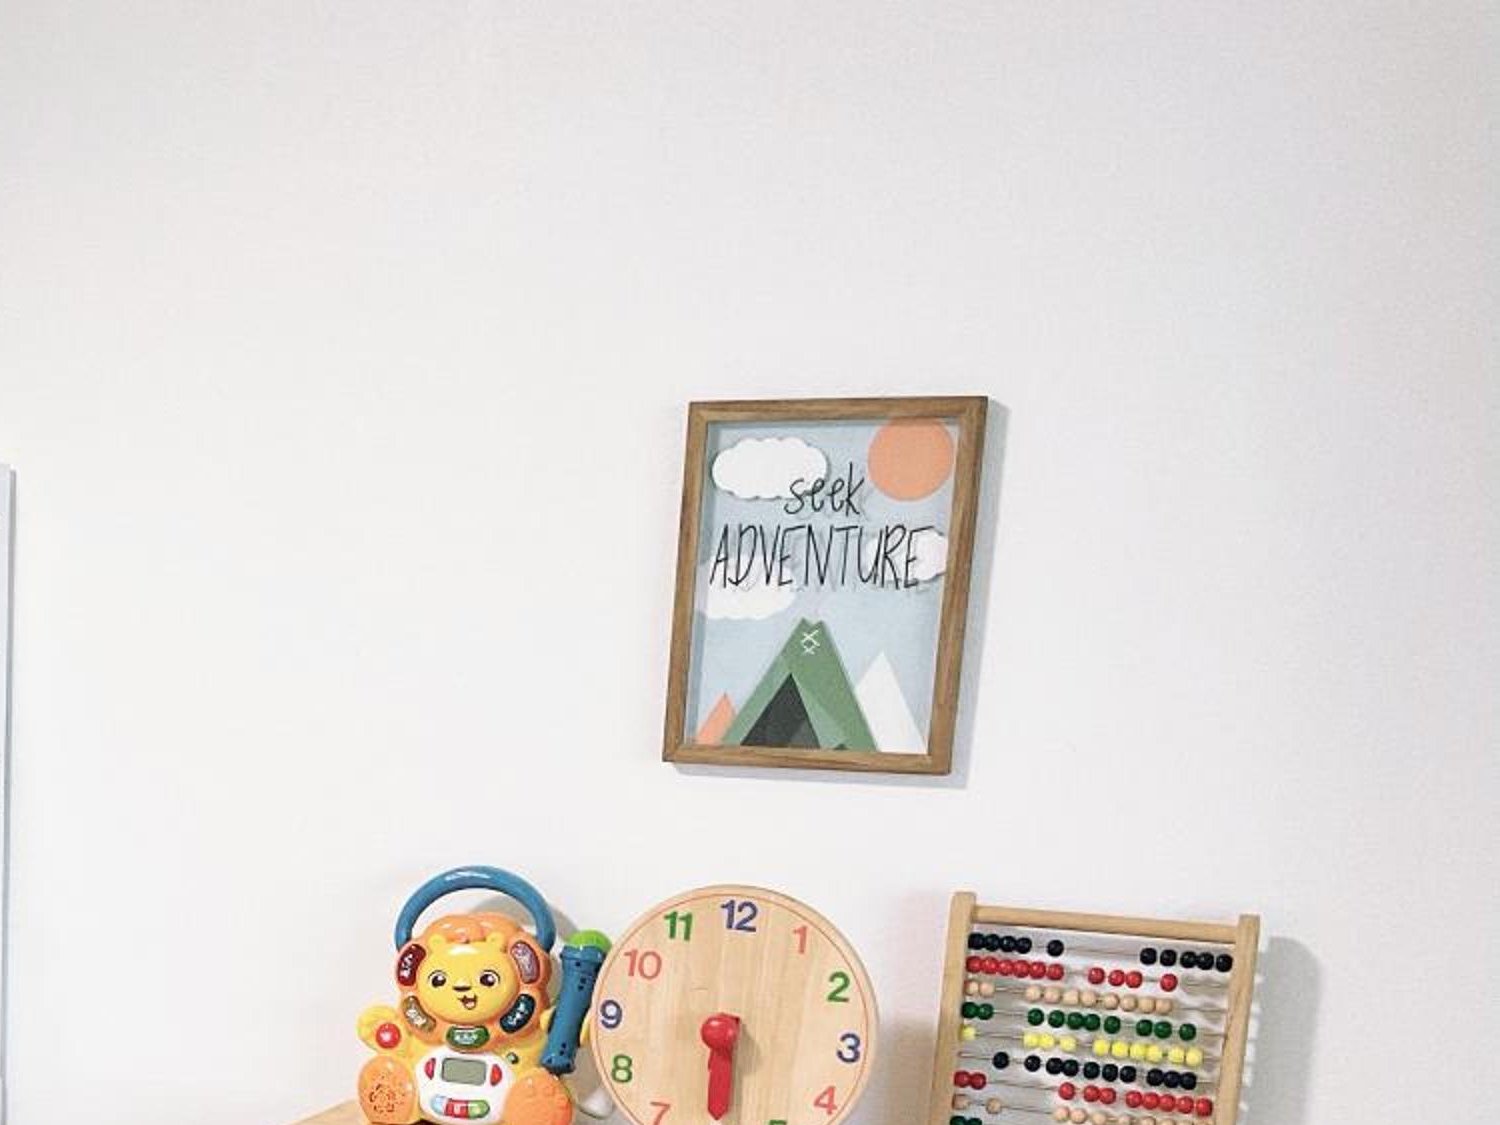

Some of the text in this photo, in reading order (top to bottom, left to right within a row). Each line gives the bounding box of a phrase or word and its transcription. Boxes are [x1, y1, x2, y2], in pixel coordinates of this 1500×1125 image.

[783, 462, 864, 515] seek
[710, 525, 935, 590] ADVENTURE
[664, 911, 693, 941] 11
[721, 900, 758, 932] 12
[794, 926, 807, 954] 1
[624, 949, 662, 979] 10
[827, 972, 850, 1002] 2
[600, 1000, 622, 1028] 9
[836, 1033, 861, 1063] 3
[611, 1054, 633, 1083] 8
[814, 1086, 838, 1115] 4
